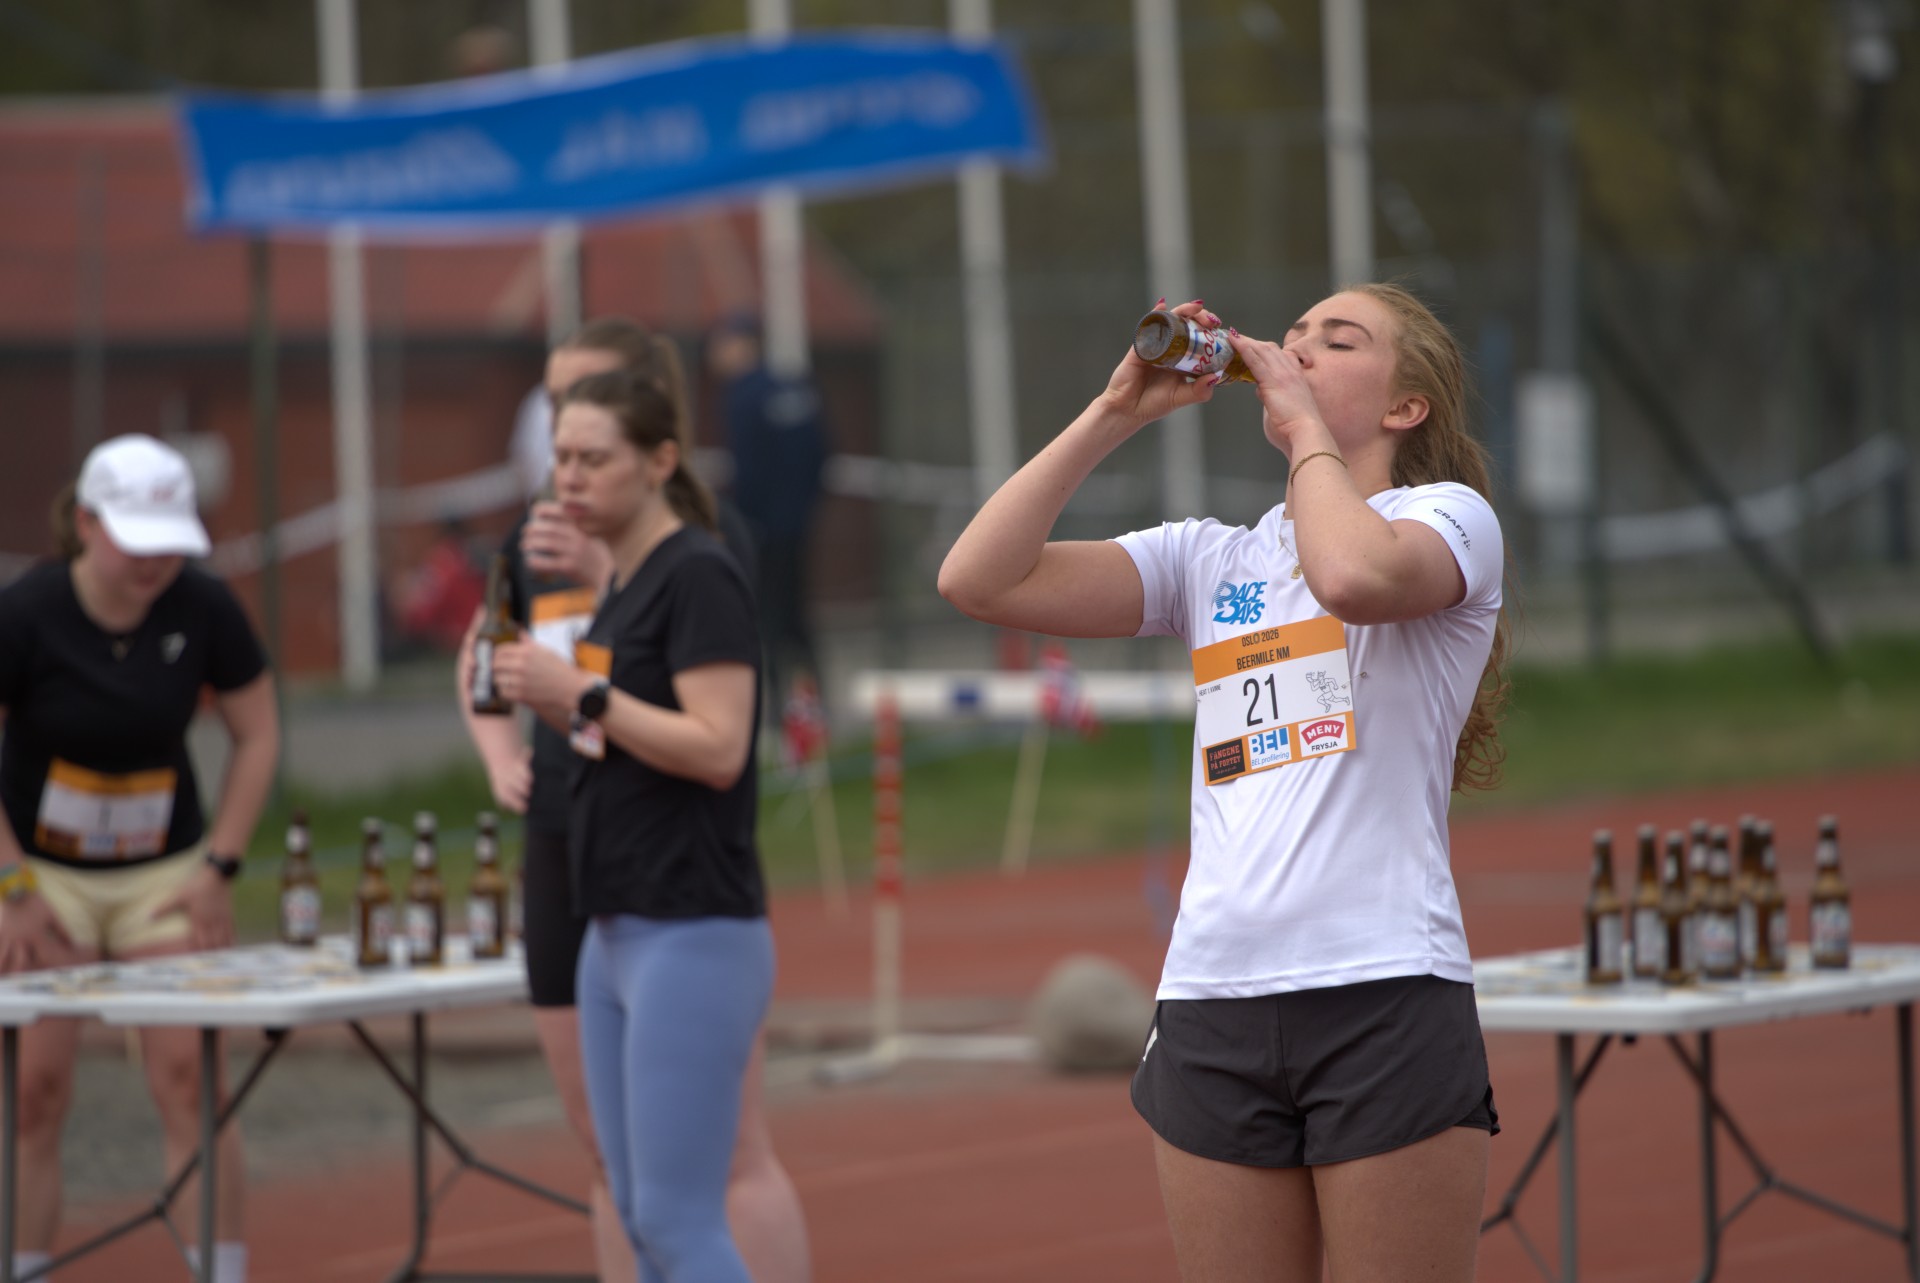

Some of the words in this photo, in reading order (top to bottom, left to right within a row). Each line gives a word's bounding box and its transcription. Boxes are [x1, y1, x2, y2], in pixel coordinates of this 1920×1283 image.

[1433, 508, 1468, 538] CRAFT
[1213, 580, 1267, 609] RACE
[1213, 600, 1265, 625] DAYS
[1241, 632, 1260, 647] OSLO
[1262, 629, 1279, 642] 2026
[1236, 649, 1275, 670] BEERMILE
[1276, 645, 1290, 660] NM
[1243, 673, 1278, 727] 21
[1250, 728, 1288, 755] BEL
[1306, 724, 1341, 740] MENY
[1209, 745, 1240, 761] FANGENE
[1251, 757, 1261, 767] BEL
[1262, 751, 1290, 765] profilering
[1311, 741, 1338, 752] FRYSJA
